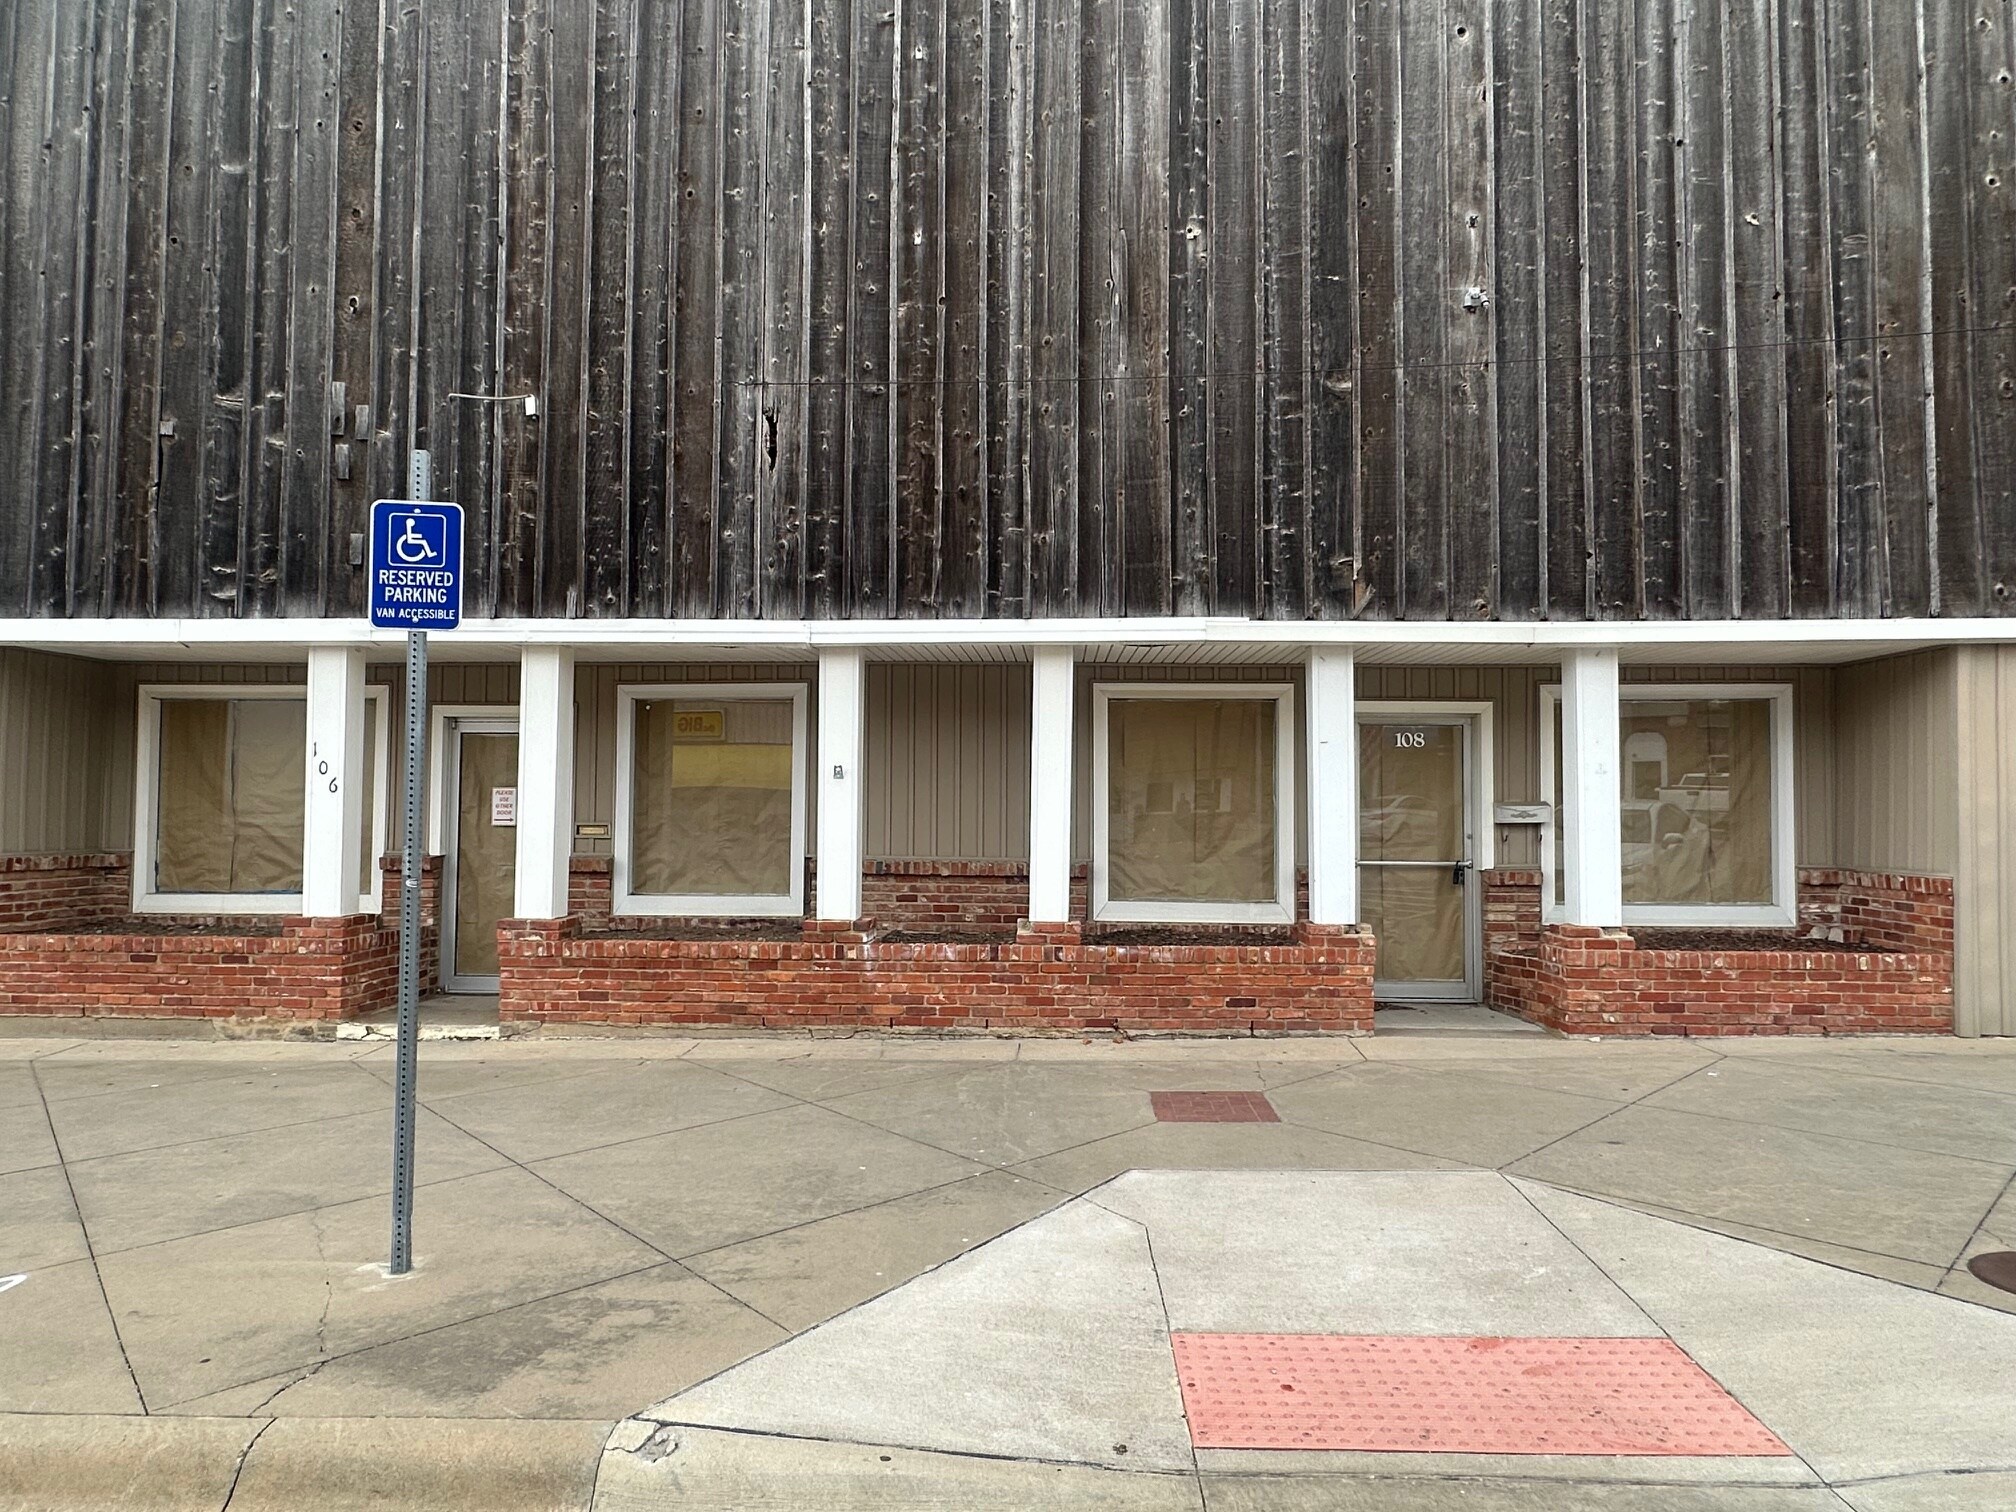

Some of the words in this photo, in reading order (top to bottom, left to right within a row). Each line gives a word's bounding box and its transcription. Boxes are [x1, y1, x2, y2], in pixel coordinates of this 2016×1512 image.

[378, 569, 454, 587] RESERVED
[384, 586, 447, 604] PARKING
[375, 607, 396, 618] VAN
[397, 608, 456, 620] ACCESSIBLE
[1394, 732, 1426, 748] 108
